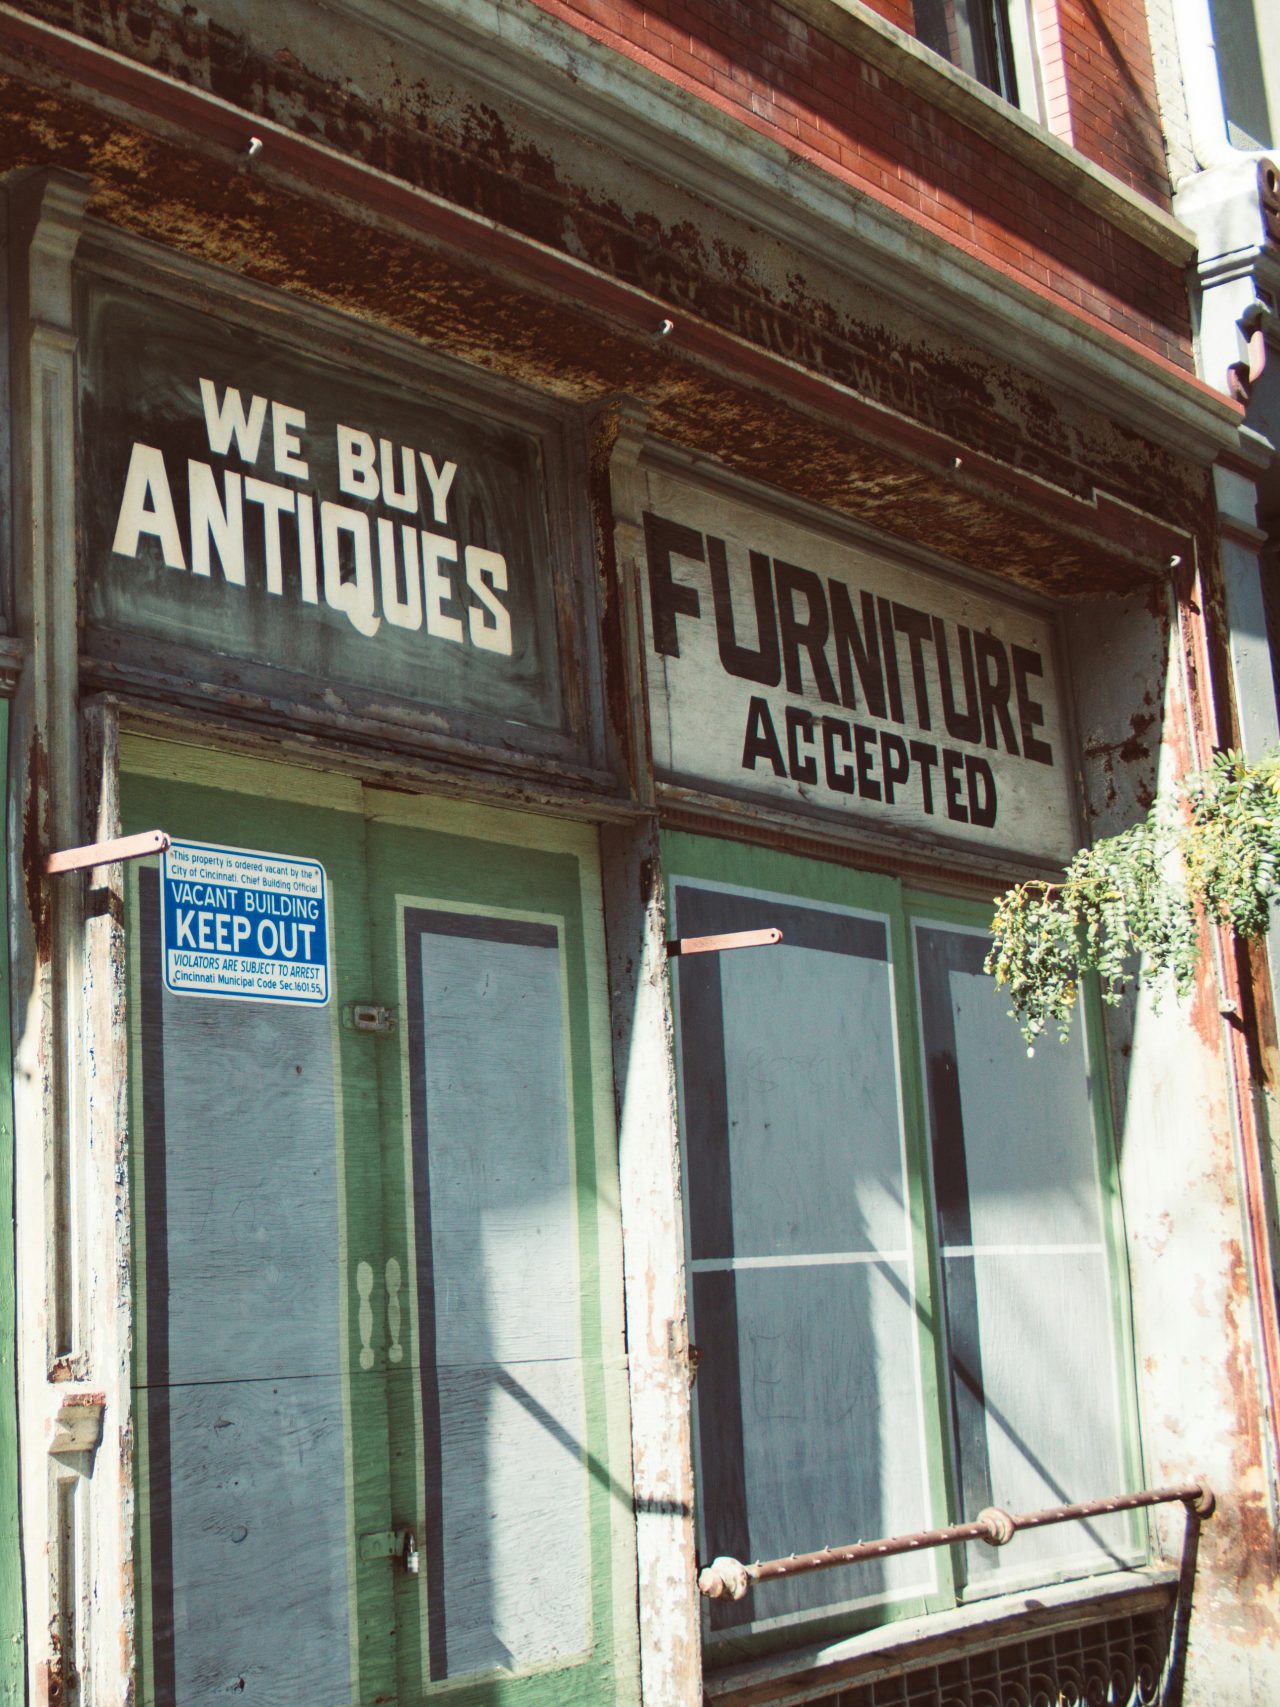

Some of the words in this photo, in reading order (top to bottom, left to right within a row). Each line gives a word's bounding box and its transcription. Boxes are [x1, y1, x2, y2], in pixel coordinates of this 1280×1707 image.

[199, 377, 309, 480] WE
[337, 423, 458, 524] BUY
[112, 442, 512, 656] ANTIQUES
[642, 511, 1054, 767] FURNITURE
[742, 696, 998, 829] ACCEPTED
[171, 864, 188, 878] City
[189, 867, 197, 877] of
[241, 874, 260, 885] Chief
[262, 877, 291, 891] Building
[293, 881, 318, 893] Official
[173, 850, 190, 861] This
[192, 854, 224, 869] property
[226, 858, 232, 867] is
[235, 860, 263, 872] ordered
[265, 865, 288, 875] vacant
[290, 867, 298, 879] by
[301, 869, 313, 879] the
[171, 882, 238, 910] VACANT
[244, 891, 320, 920] BUILDING
[176, 908, 252, 953] KEEP
[257, 919, 316, 961] OUT
[174, 954, 220, 970] VIOLATORS
[222, 958, 238, 972] ARE
[240, 960, 276, 975] SUBJECT
[278, 964, 289, 976] TO
[290, 965, 321, 979] ARREST
[175, 969, 216, 983] Cincinnati
[218, 974, 255, 988] Municipal
[256, 978, 277, 989] Code
